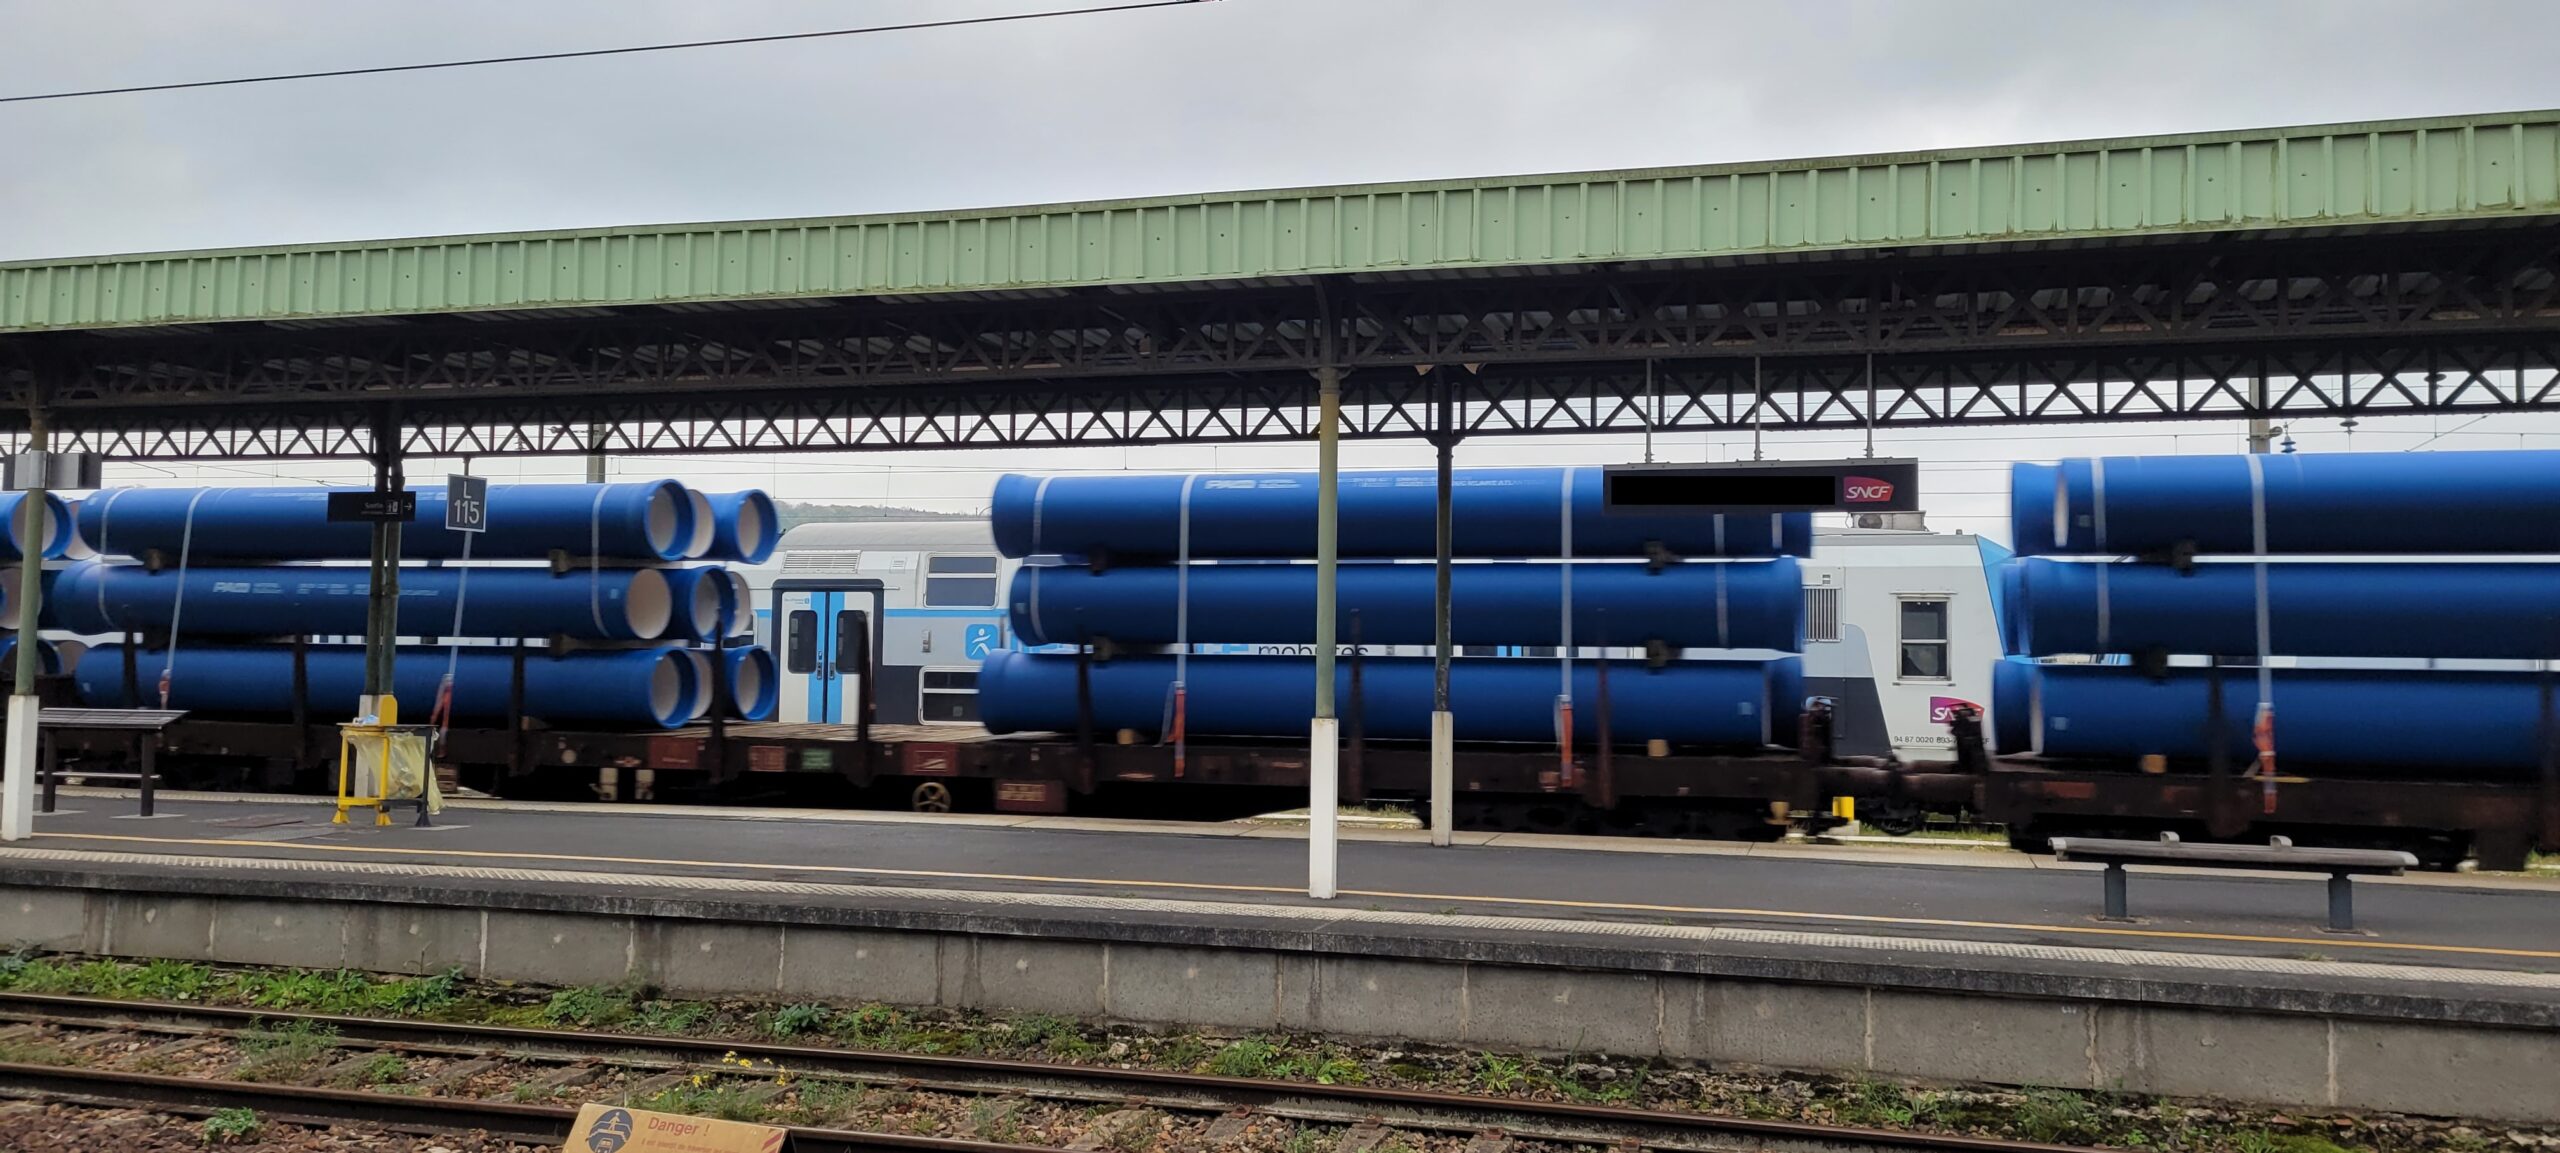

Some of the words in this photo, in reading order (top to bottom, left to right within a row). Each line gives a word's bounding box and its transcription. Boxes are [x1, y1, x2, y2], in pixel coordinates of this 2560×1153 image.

[463, 480, 472, 499] L
[1845, 486, 1891, 499] SNCF
[454, 499, 480, 525] 115
[1894, 735, 1903, 743] 94
[1905, 735, 1913, 743] 87
[1916, 736, 1934, 744] 0020
[648, 1116, 699, 1137] Danger
[703, 1124, 711, 1136] !
